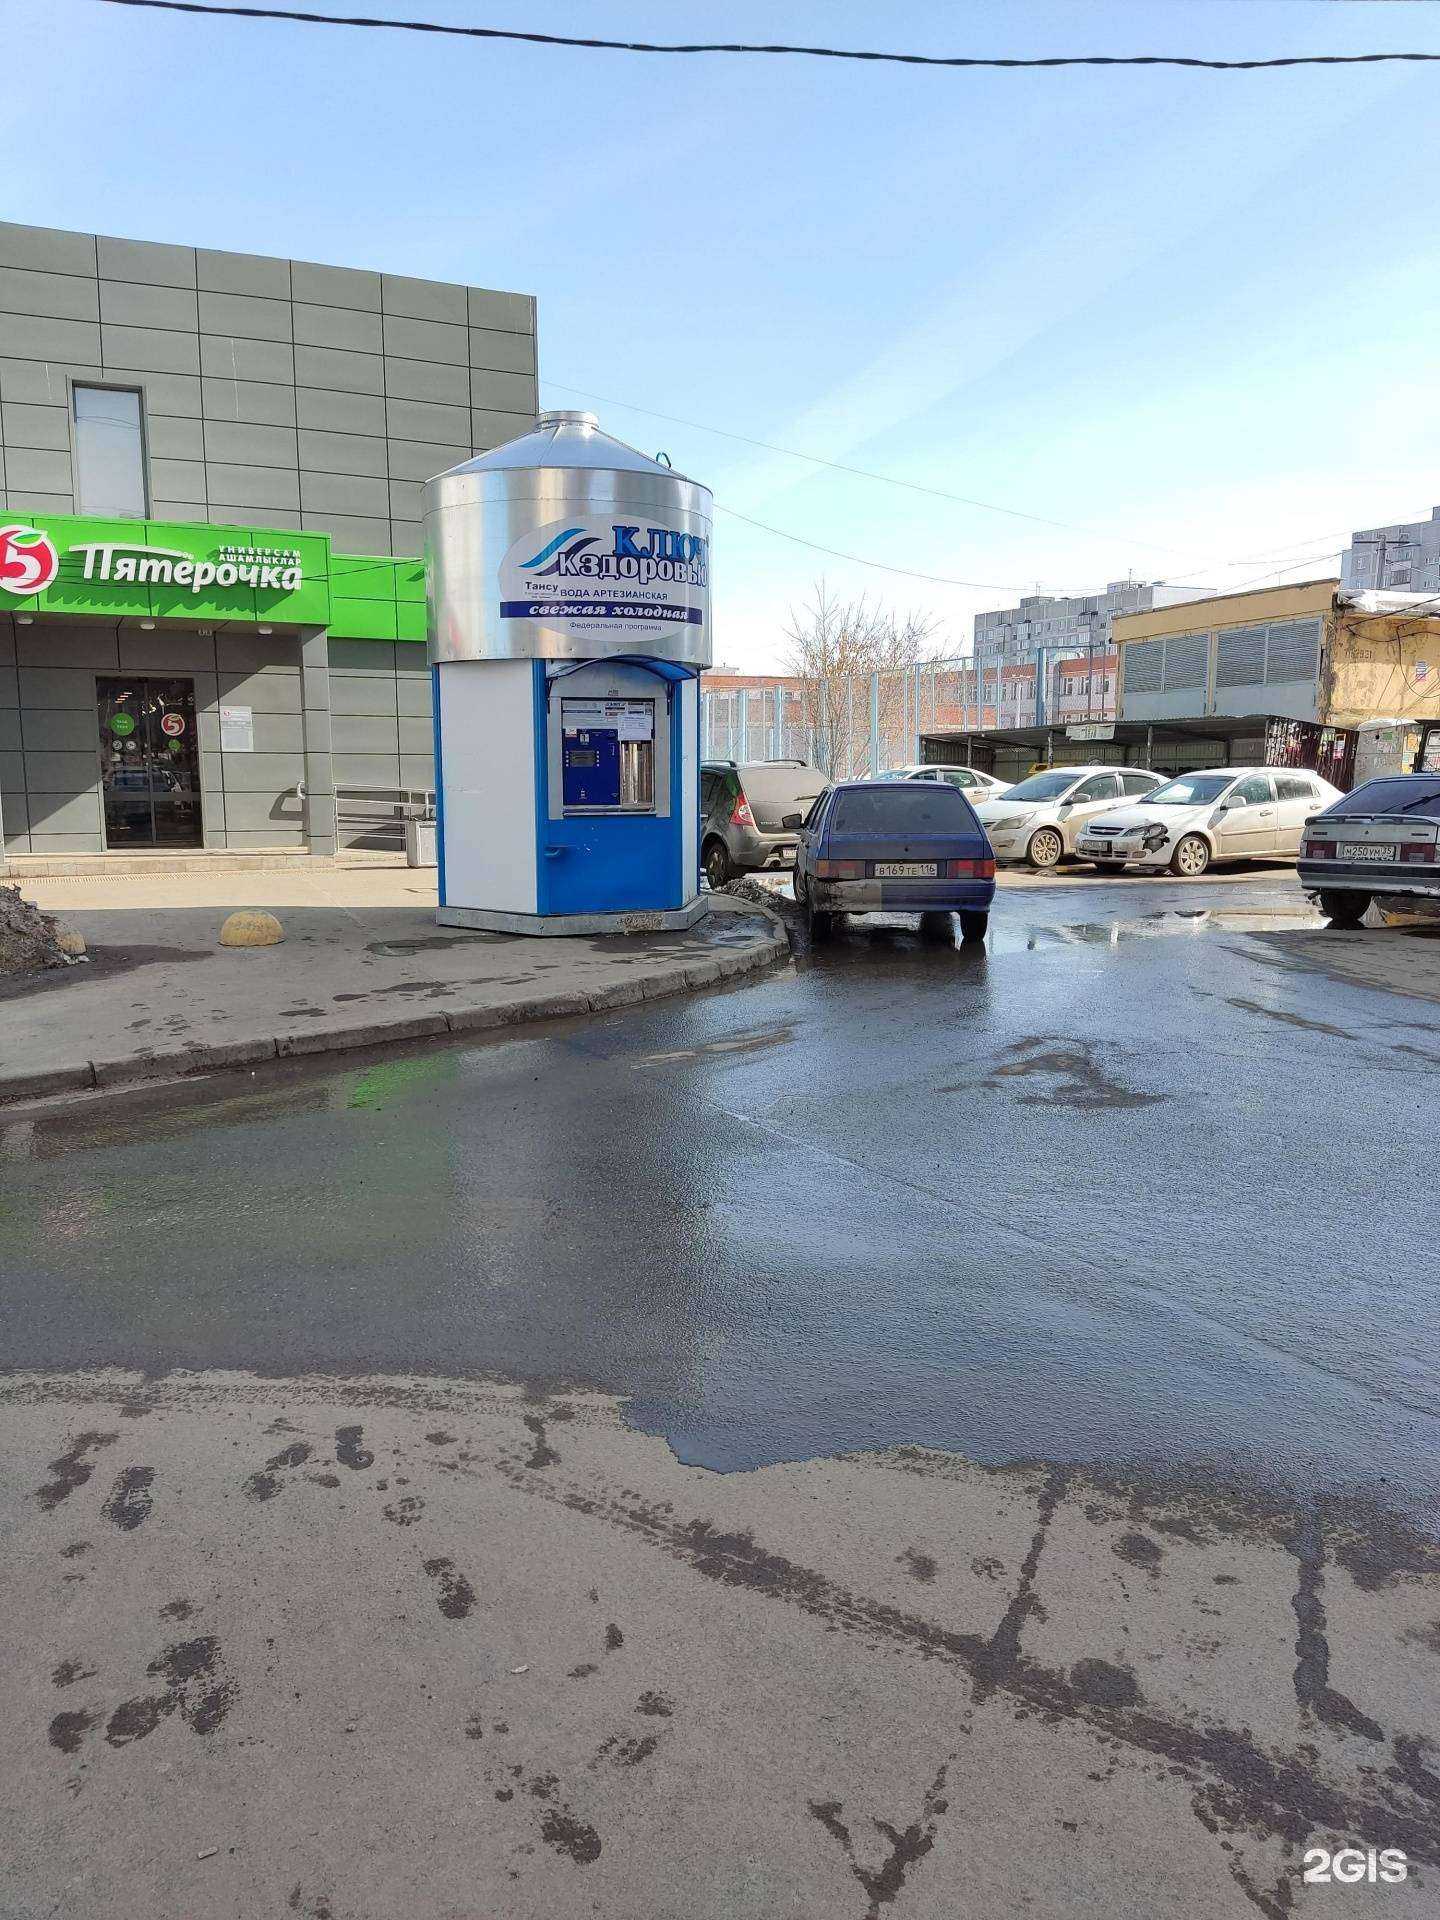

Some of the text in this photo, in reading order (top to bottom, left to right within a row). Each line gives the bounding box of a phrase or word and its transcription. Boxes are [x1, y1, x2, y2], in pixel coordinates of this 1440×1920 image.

[218, 545, 301, 557] УНИВЕРСАМ
[218, 553, 302, 566] АШАМЛЫКЛАР
[525, 582, 558, 592] Тансу
[560, 589, 590, 598] ВОДА
[593, 589, 668, 601] АРТЕЗИАНСКАЯ
[529, 605, 689, 620] свежая холодная
[569, 622, 623, 630] Федеральная
